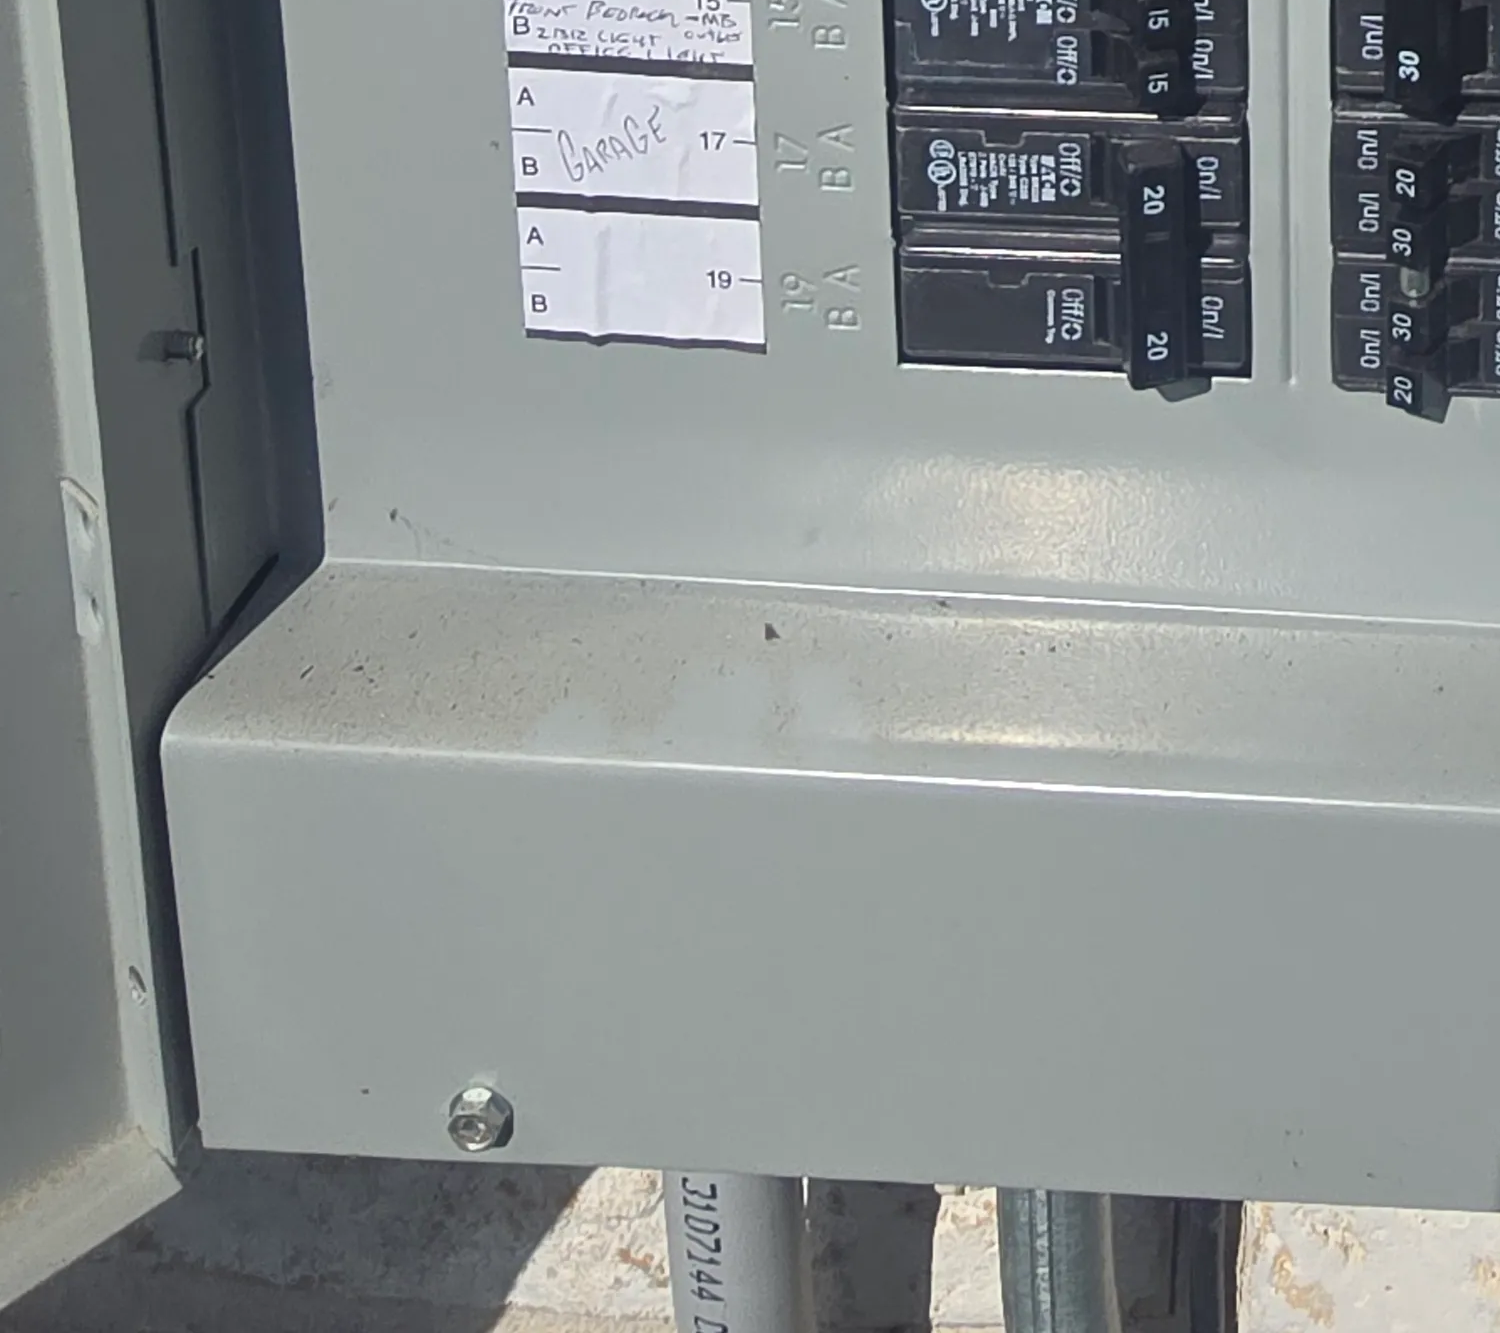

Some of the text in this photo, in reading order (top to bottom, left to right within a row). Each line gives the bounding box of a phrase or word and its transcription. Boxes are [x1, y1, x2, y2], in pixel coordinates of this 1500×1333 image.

[1149, 9, 1168, 29] 15
[1399, 51, 1419, 81] 30
[1149, 73, 1168, 93] 15
[557, 104, 667, 183] GARAGE
[700, 132, 725, 150] 17
[1396, 169, 1414, 197] 20
[1144, 186, 1164, 214] 20
[1393, 229, 1411, 256] 30
[707, 271, 731, 289] 19
[1393, 314, 1411, 341] 30
[1148, 333, 1168, 360] 20
[1394, 377, 1412, 404] 20
[681, 1176, 724, 1303] 3107144
